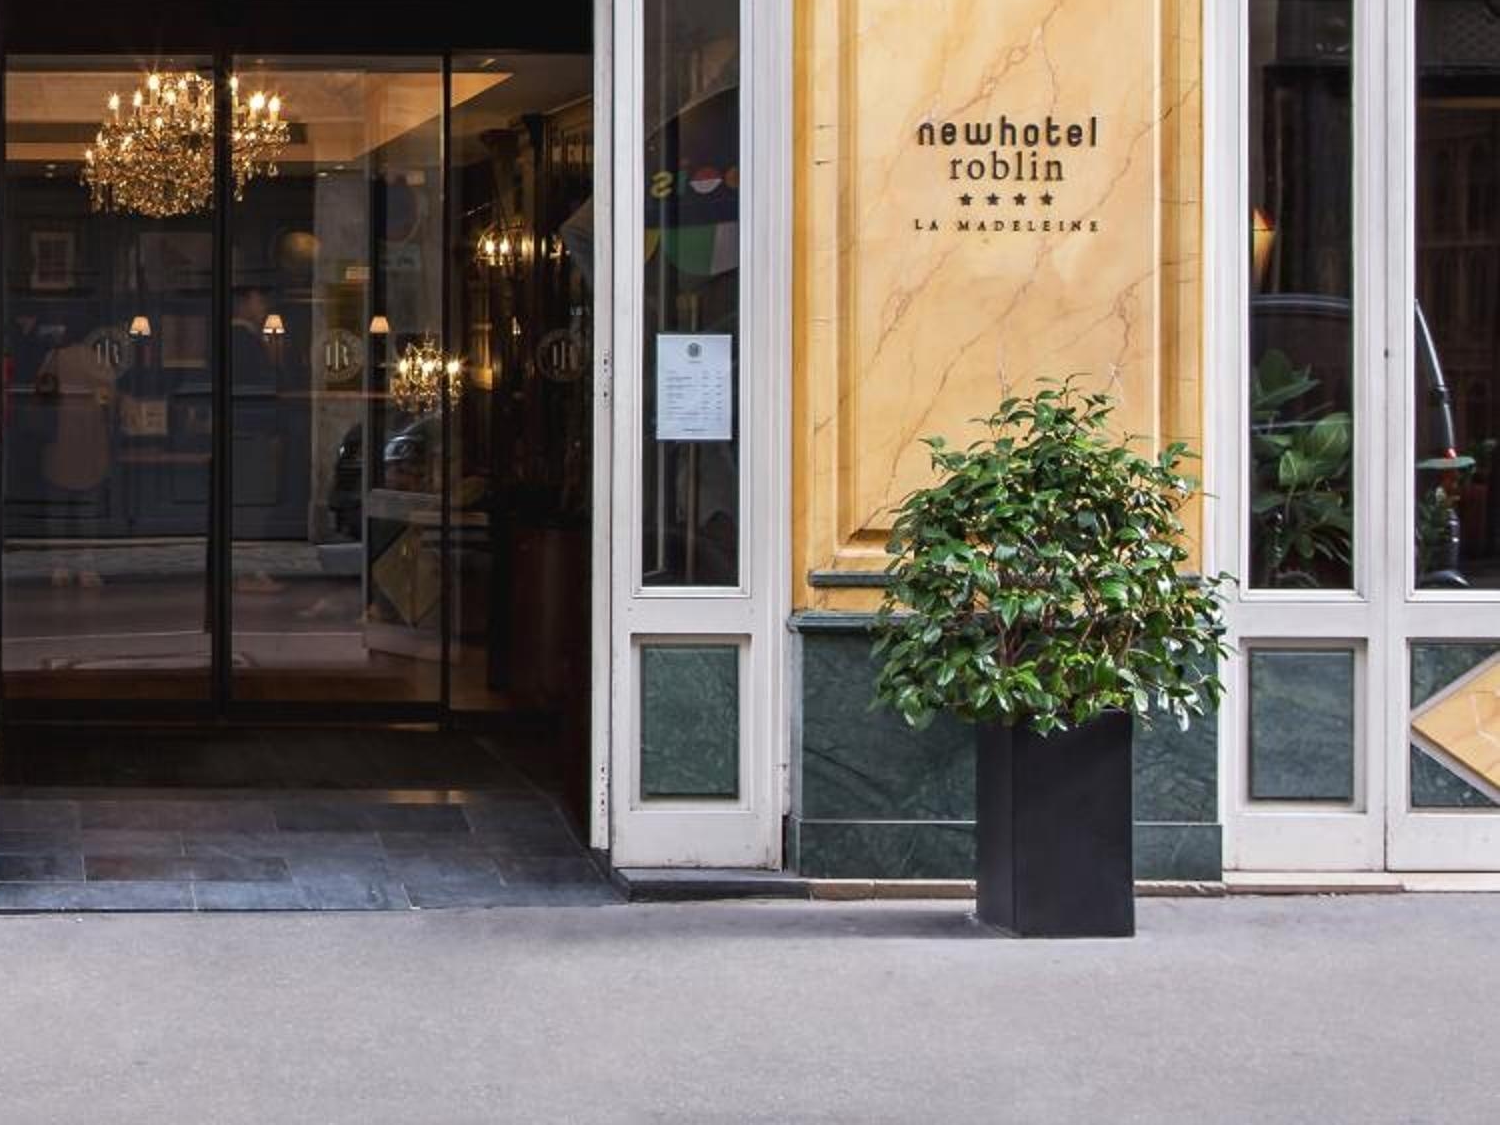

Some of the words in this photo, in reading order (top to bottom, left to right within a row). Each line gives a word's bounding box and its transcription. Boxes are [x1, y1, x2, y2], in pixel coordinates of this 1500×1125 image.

[917, 115, 1097, 146] newhotel
[949, 150, 1064, 181] roblin
[914, 219, 939, 231] LA
[957, 220, 1099, 232] MADELEINE
